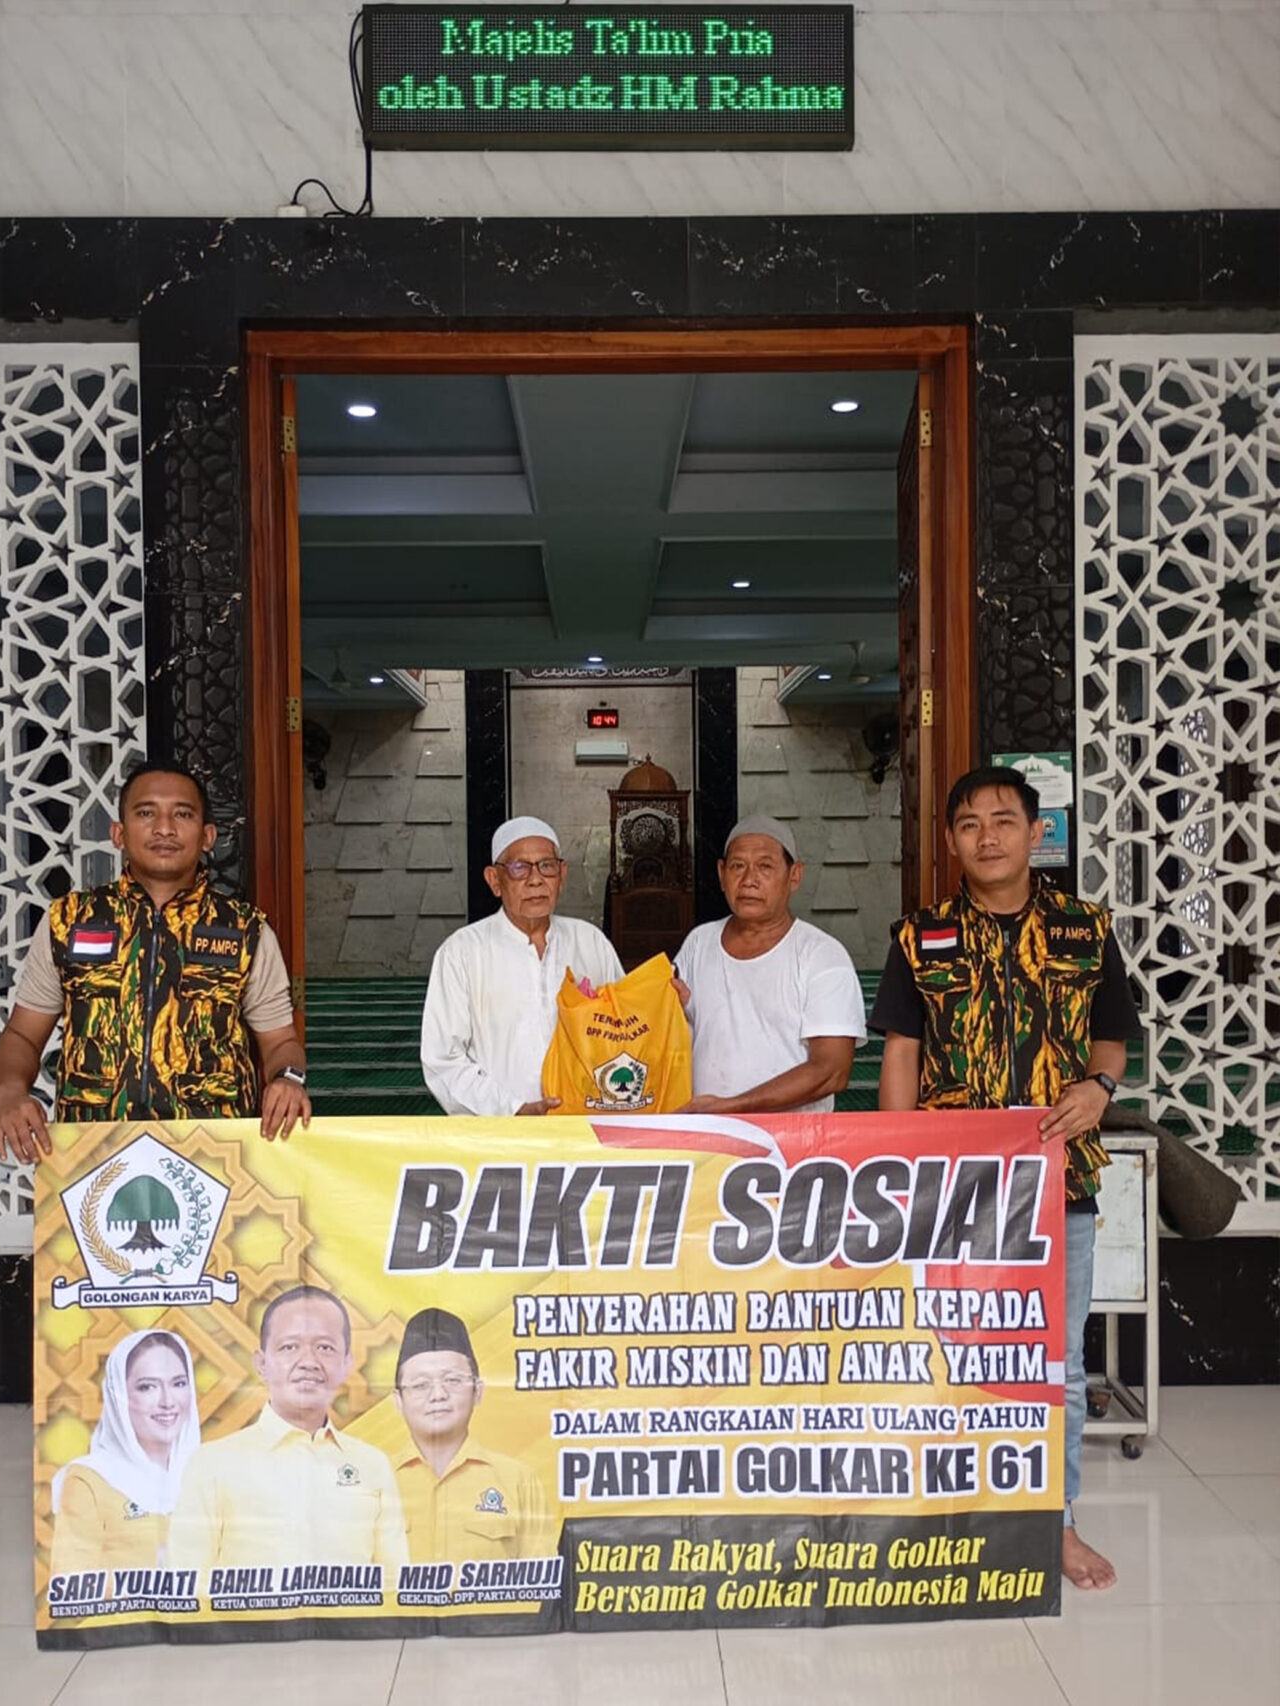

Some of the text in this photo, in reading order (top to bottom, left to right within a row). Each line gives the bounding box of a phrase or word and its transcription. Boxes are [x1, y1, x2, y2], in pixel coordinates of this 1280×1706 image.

[439, 18, 774, 62] Majelis Ta'lim Pria
[378, 75, 845, 110] oleh Ustadz HM Rahma
[195, 937, 239, 956] PP AMPG
[1049, 925, 1092, 942] PP AMPG
[386, 1158, 1051, 1272] BAKTI SOSIAL
[83, 1290, 208, 1304] GOLONGAN KARYA
[514, 1287, 1048, 1337] PENYERAHAN BANTUAN KEPADA
[515, 1341, 1048, 1390] FAKIR MISKIN DAN ANAK YATIM
[553, 1406, 1047, 1435] DALAM RANGKAIAN HARI ULANG TAHUN
[562, 1444, 1044, 1498] PARTAI GOLKAR KE 61
[575, 1535, 986, 1576] Suara Rakyat, Suara Golkar
[49, 1570, 197, 1602] SARI YULIATI
[209, 1565, 382, 1595] BAHLIL LAHADALIA
[399, 1559, 562, 1590] MHD SARMUJI
[212, 1593, 382, 1610] KETUA UMUM DPP PARTAI GOLKAR
[399, 1588, 562, 1605] SEKJEND. DPP PARTAI GOLKAR
[574, 1567, 1046, 1614] Bersama Golkar Indonesia Maju
[51, 1600, 198, 1618] BENDUM DPP PARTAI GOLKAR
